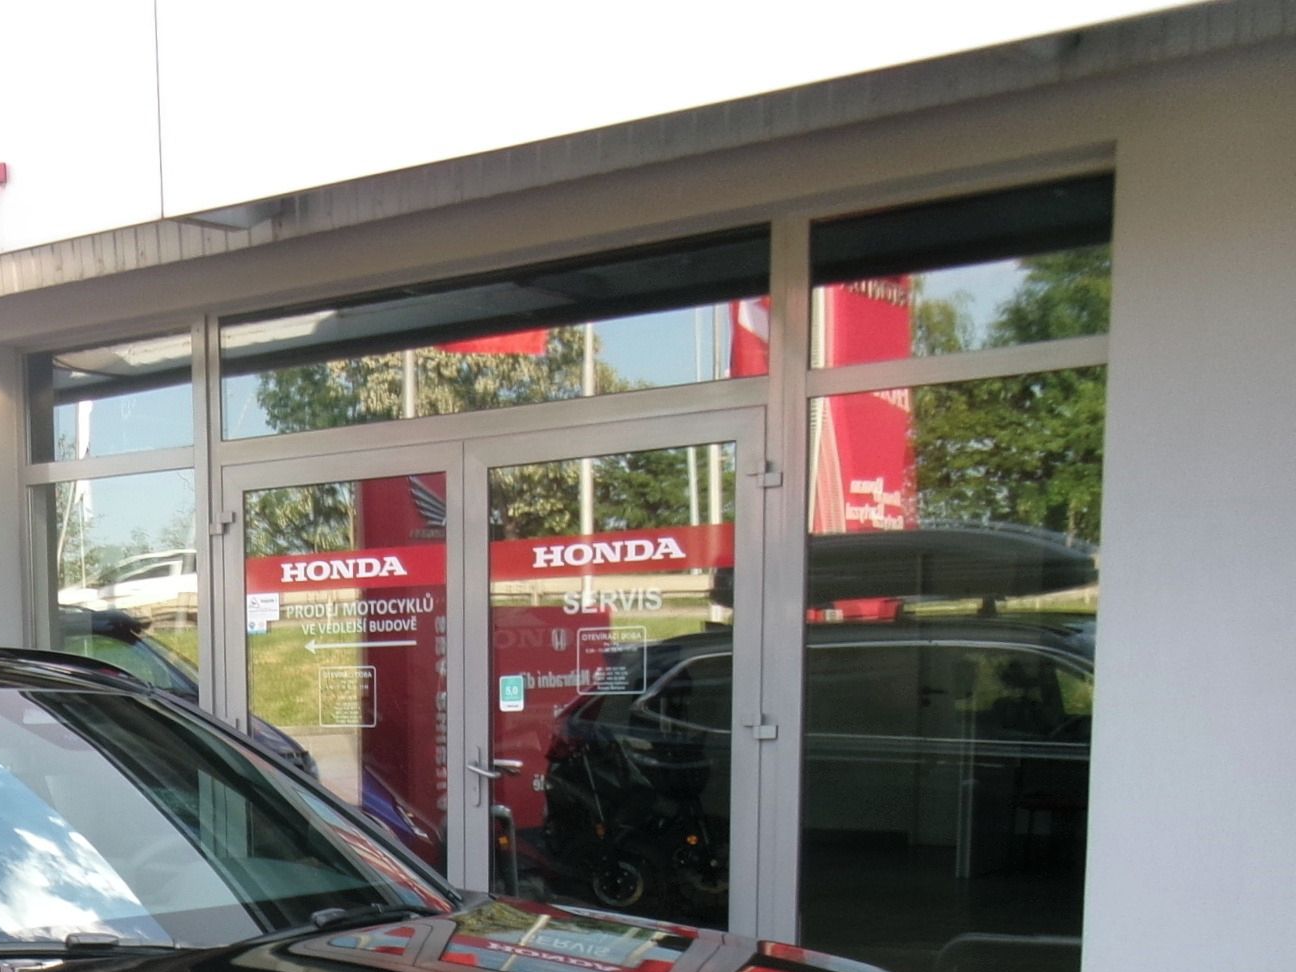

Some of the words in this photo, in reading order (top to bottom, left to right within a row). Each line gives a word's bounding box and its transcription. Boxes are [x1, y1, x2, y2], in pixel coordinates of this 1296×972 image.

[532, 537, 686, 568] HONDA
[281, 556, 407, 583] HONDA
[286, 601, 339, 619] PRODEJ
[342, 592, 434, 617] MOTOCYKLŮ
[562, 587, 663, 615] SERVIS
[301, 623, 316, 635] VE
[319, 618, 366, 635] VEDLEJŠÍ
[369, 615, 417, 632] BUDOVĚ
